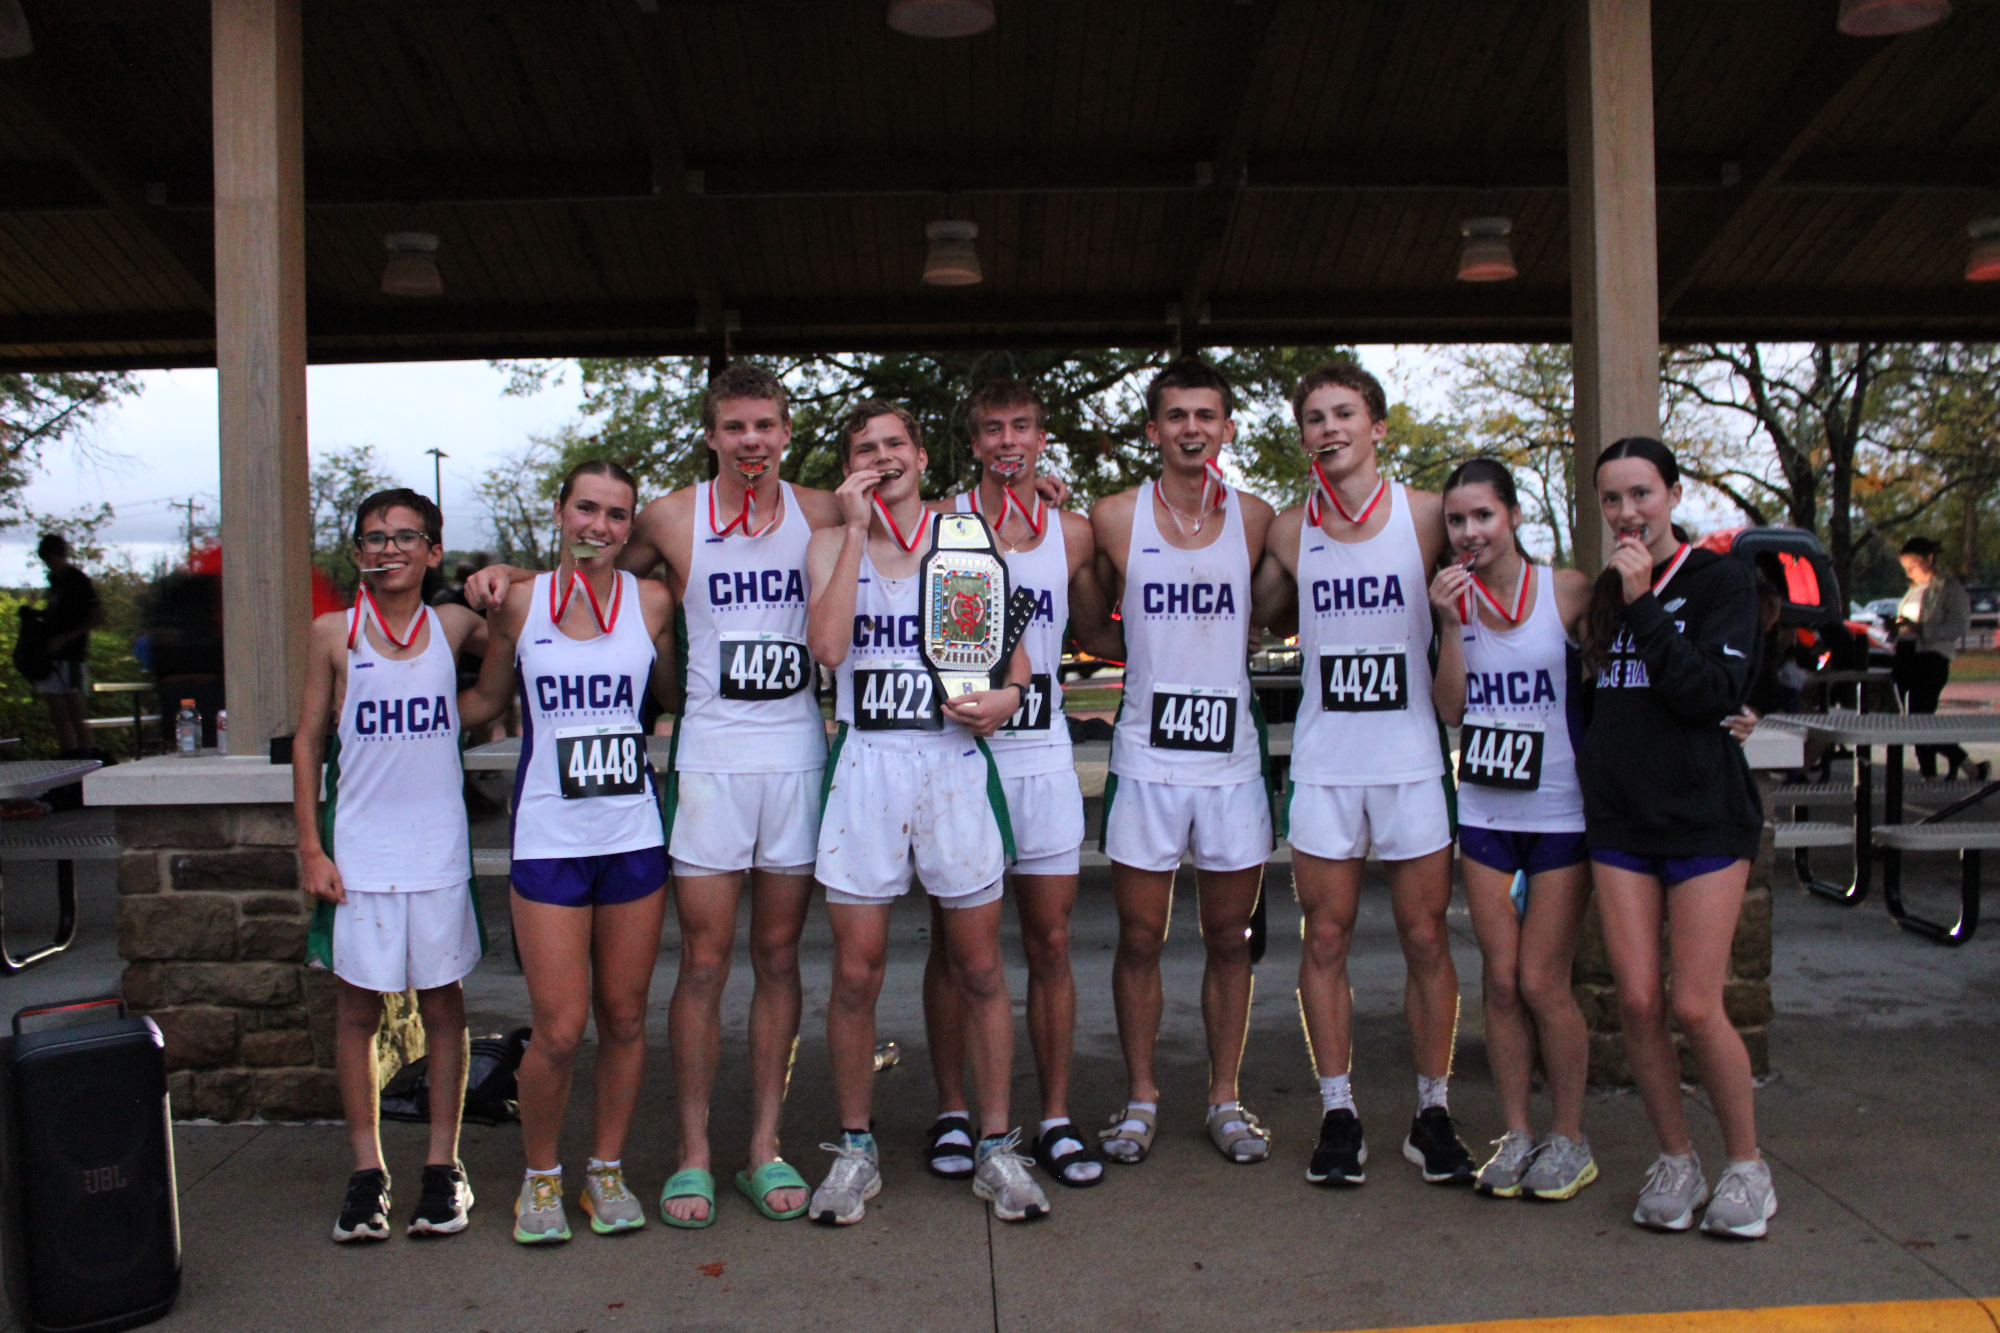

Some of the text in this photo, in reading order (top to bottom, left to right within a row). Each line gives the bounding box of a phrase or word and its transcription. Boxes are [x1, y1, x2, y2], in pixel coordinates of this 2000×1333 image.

[709, 570, 805, 606] CHCA
[933, 576, 942, 639] CHAMPION
[1143, 583, 1235, 614] CHCA
[1313, 575, 1405, 612] CHCA
[853, 614, 921, 647] CHC
[961, 593, 974, 635] MVC
[730, 644, 802, 690] 4423
[1330, 656, 1398, 702] 4424
[1466, 669, 1556, 706] CHCA
[536, 674, 633, 712] CHCA
[862, 672, 934, 719] 4422
[356, 695, 451, 735] CHCA
[1159, 696, 1228, 743] 4430
[568, 737, 638, 787] 4448
[1466, 729, 1534, 780] 4442
[83, 1164, 127, 1194] JBL
